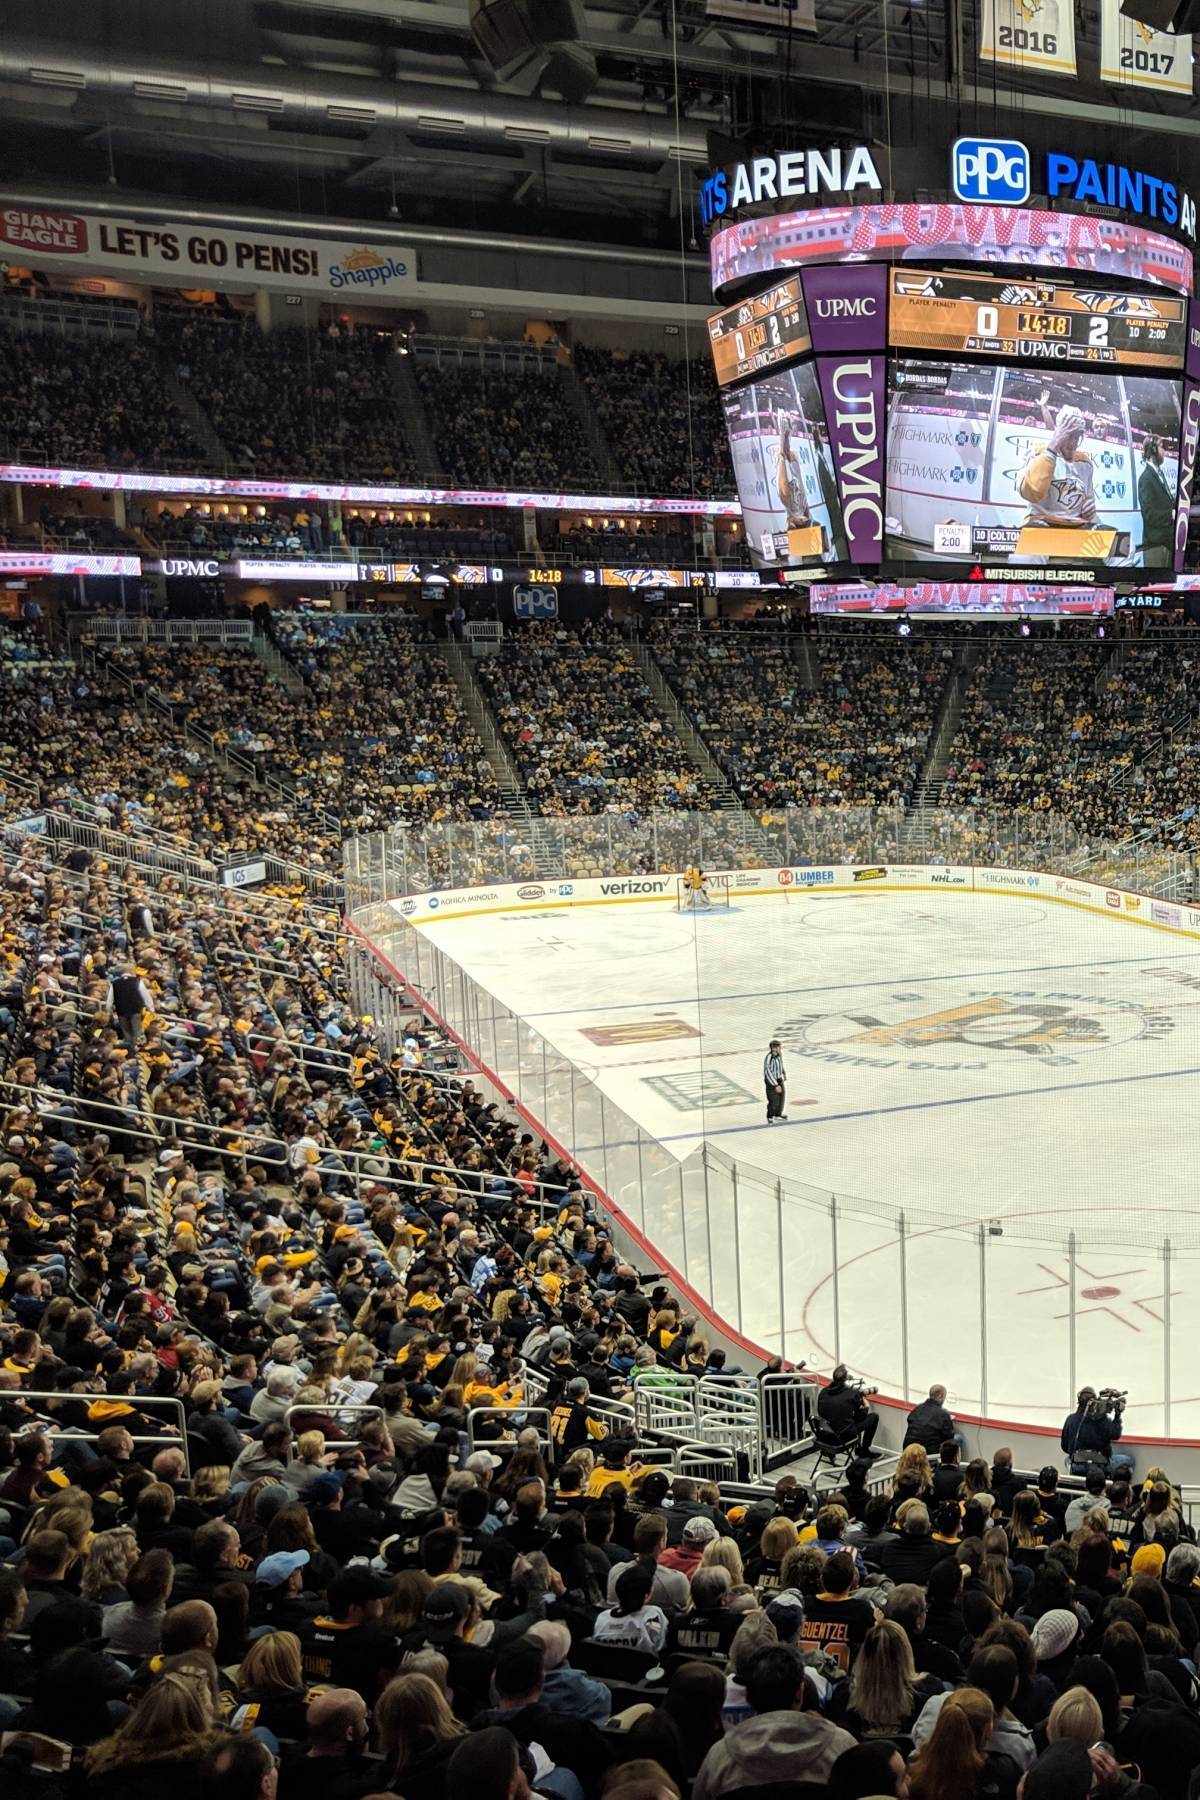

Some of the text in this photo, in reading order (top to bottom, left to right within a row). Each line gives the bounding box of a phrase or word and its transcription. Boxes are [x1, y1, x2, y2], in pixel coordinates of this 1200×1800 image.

[999, 26, 1057, 55] 2016
[1120, 47, 1174, 76] 2017
[731, 146, 882, 208] ARENA
[959, 147, 1024, 195] PPG
[1047, 152, 1178, 224] PAINTS
[3, 209, 78, 232] GIANT
[6, 226, 78, 249] EAGLE
[100, 224, 320, 277] LET'S GO PENS!
[329, 257, 408, 288] Snapple
[1041, 291, 1049, 301] 3
[816, 297, 877, 318] UPMC
[769, 314, 782, 346] 2
[977, 306, 999, 336] 0
[1022, 314, 1067, 335] 14:18
[1088, 316, 1109, 346] 2
[1128, 327, 1166, 340] 10 2:00
[735, 332, 747, 361] 0
[1002, 340, 1014, 352] 32
[1019, 340, 1068, 359] UPMC
[1087, 347, 1099, 360] 24
[893, 425, 953, 446] HIGHMARK
[832, 358, 884, 541] UPMC
[888, 458, 948, 482] HIGHMARK
[941, 536, 961, 548] 2:00
[975, 529, 987, 541] 10
[160, 559, 219, 577] UPMC
[372, 570, 386, 581] 32
[529, 569, 562, 583] 14:18
[584, 570, 595, 583] 2
[984, 567, 1096, 582] MITSUBISHI ELECTRIC
[692, 577, 705, 587] 24
[733, 578, 741, 586] 10
[516, 587, 556, 614] PPG
[701, 587, 720, 597] 119
[1128, 596, 1162, 607] YARD
[795, 871, 834, 882] LUMBER
[985, 872, 1026, 886] HIGHMARK
[600, 879, 663, 896] verizon
[467, 892, 499, 903] MINOLTA
[801, 1620, 850, 1642] GUENTZEL
